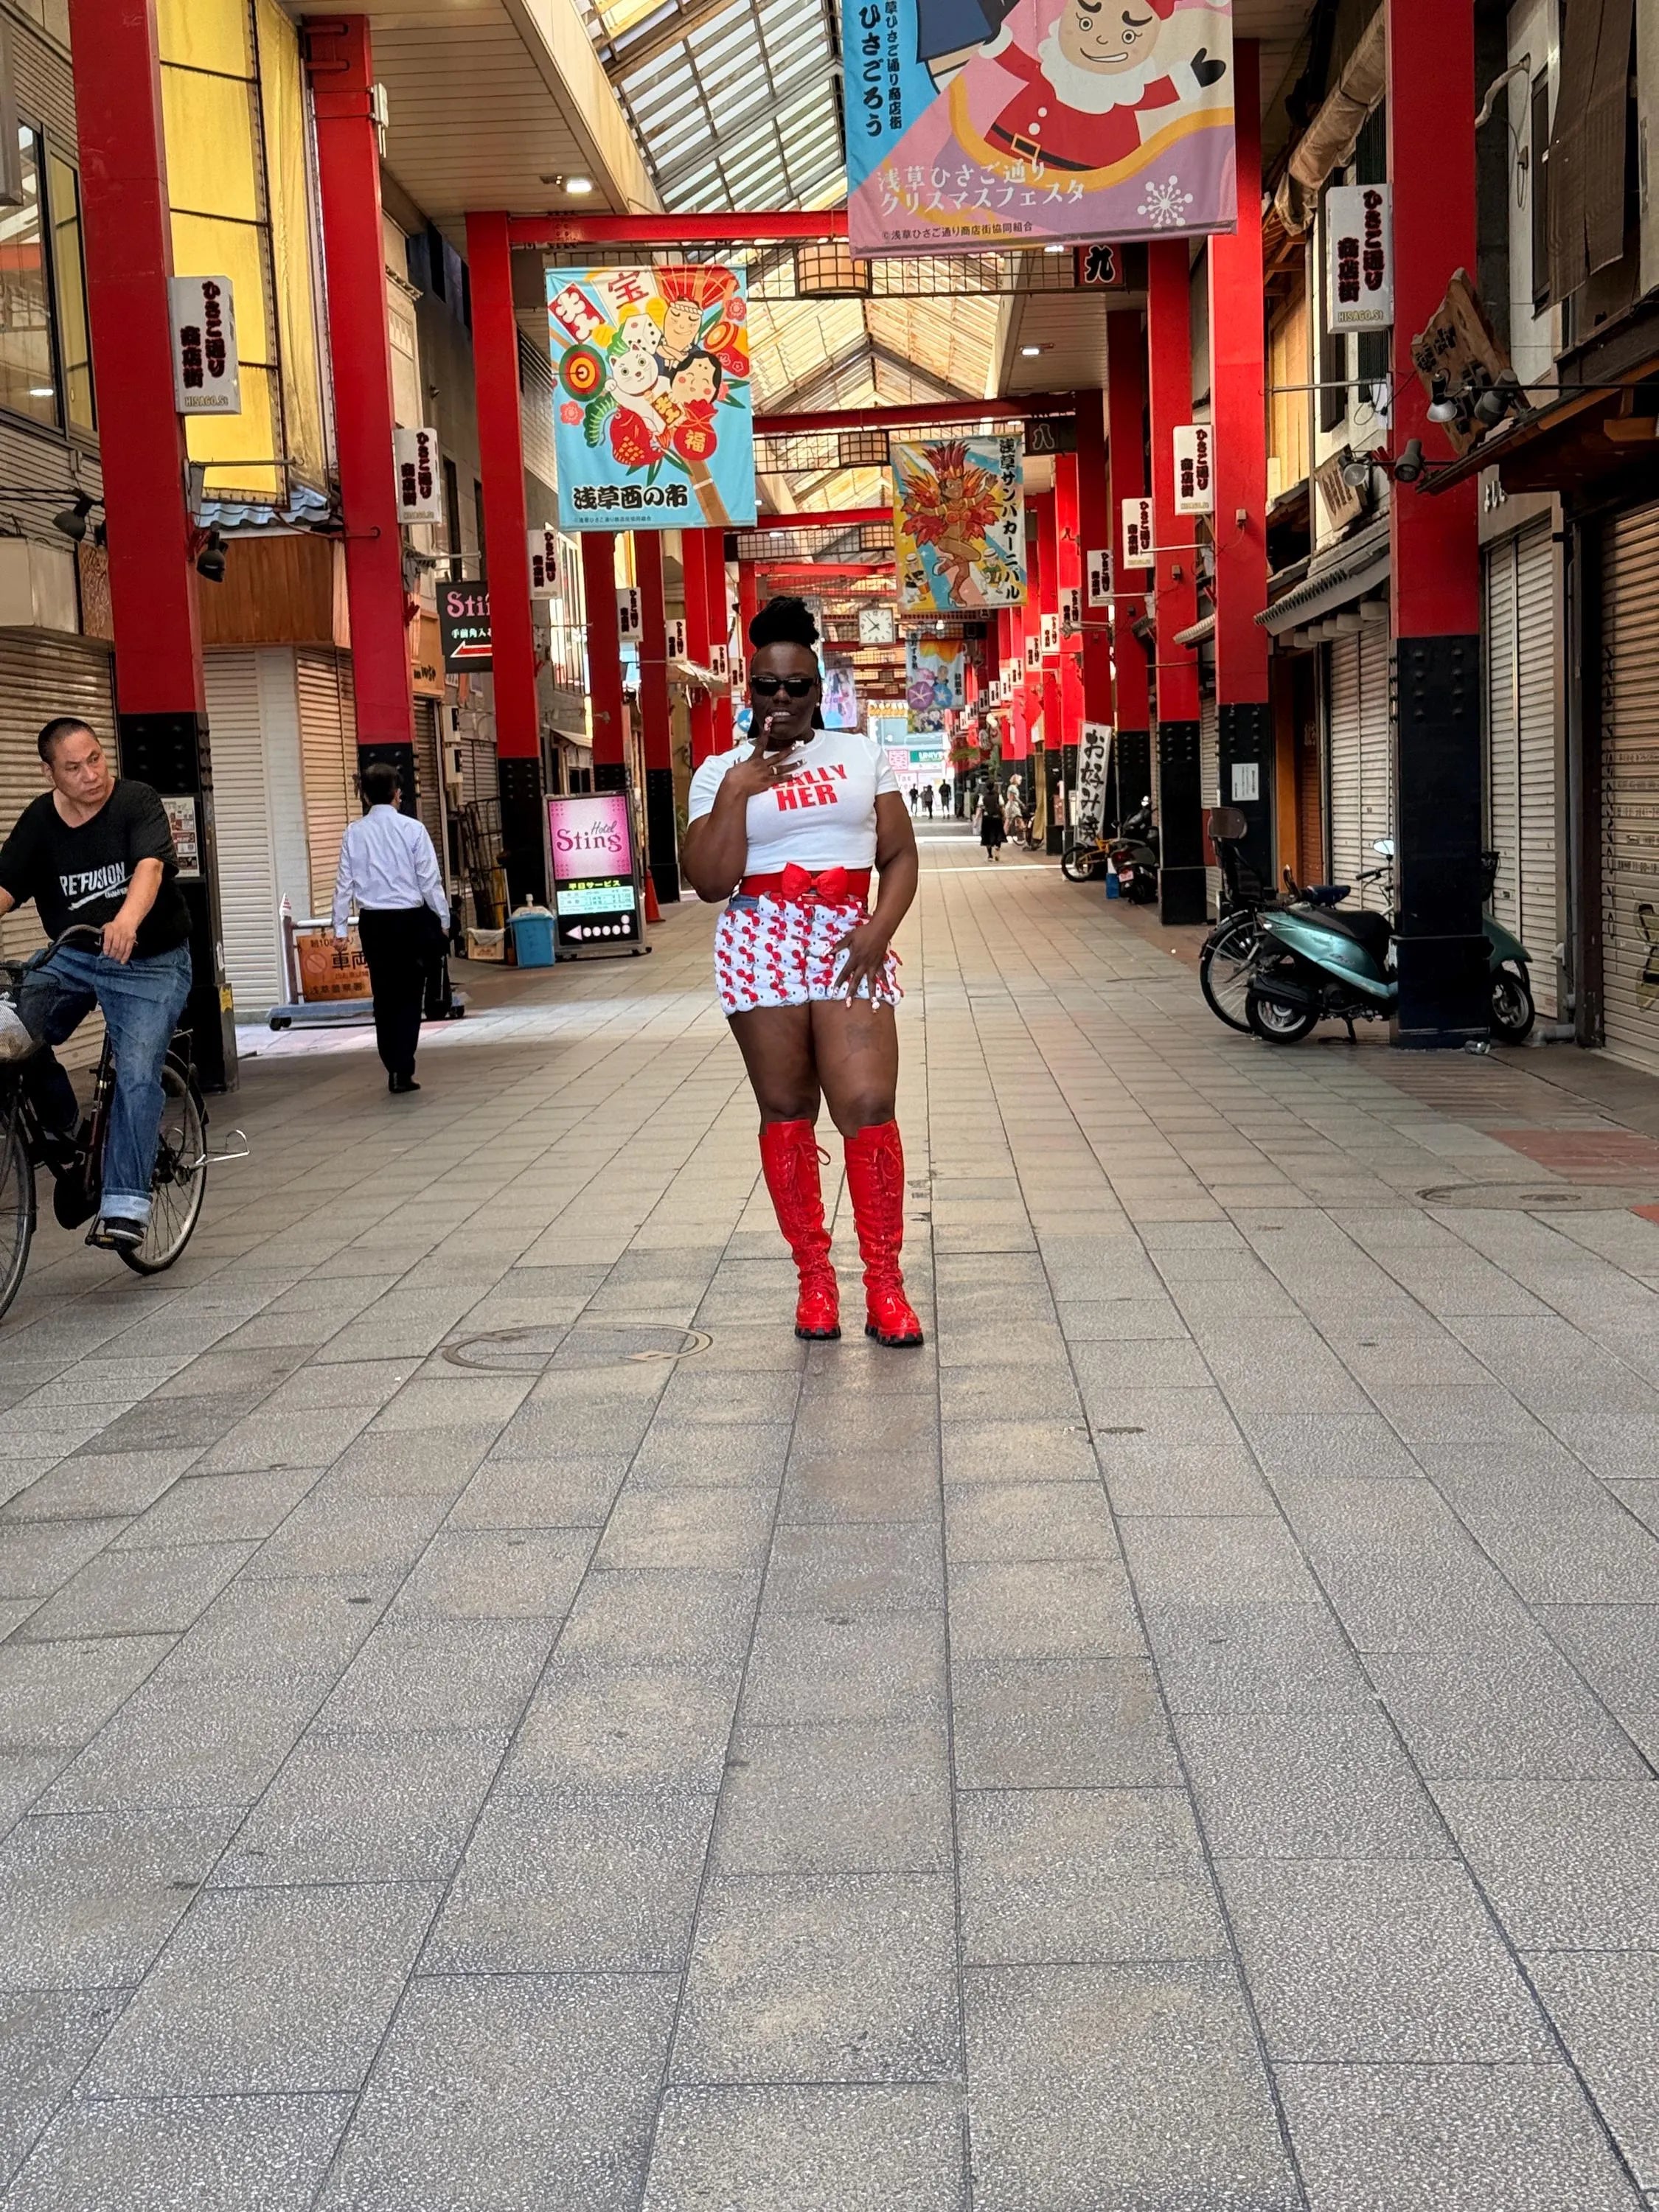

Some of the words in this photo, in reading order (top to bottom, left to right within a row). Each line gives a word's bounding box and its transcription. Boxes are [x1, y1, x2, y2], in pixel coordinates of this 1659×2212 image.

[859, 4, 884, 137] ひさごろう
[877, 159, 1045, 193] 浅草ひさご通り
[880, 179, 1085, 217] クリスマスフェスタ
[608, 271, 650, 310] 宝
[684, 429, 707, 453] 福
[999, 438, 1020, 599] 浅草サンバカーニバル
[776, 784, 838, 812] HER
[592, 821, 617, 835] Hotel
